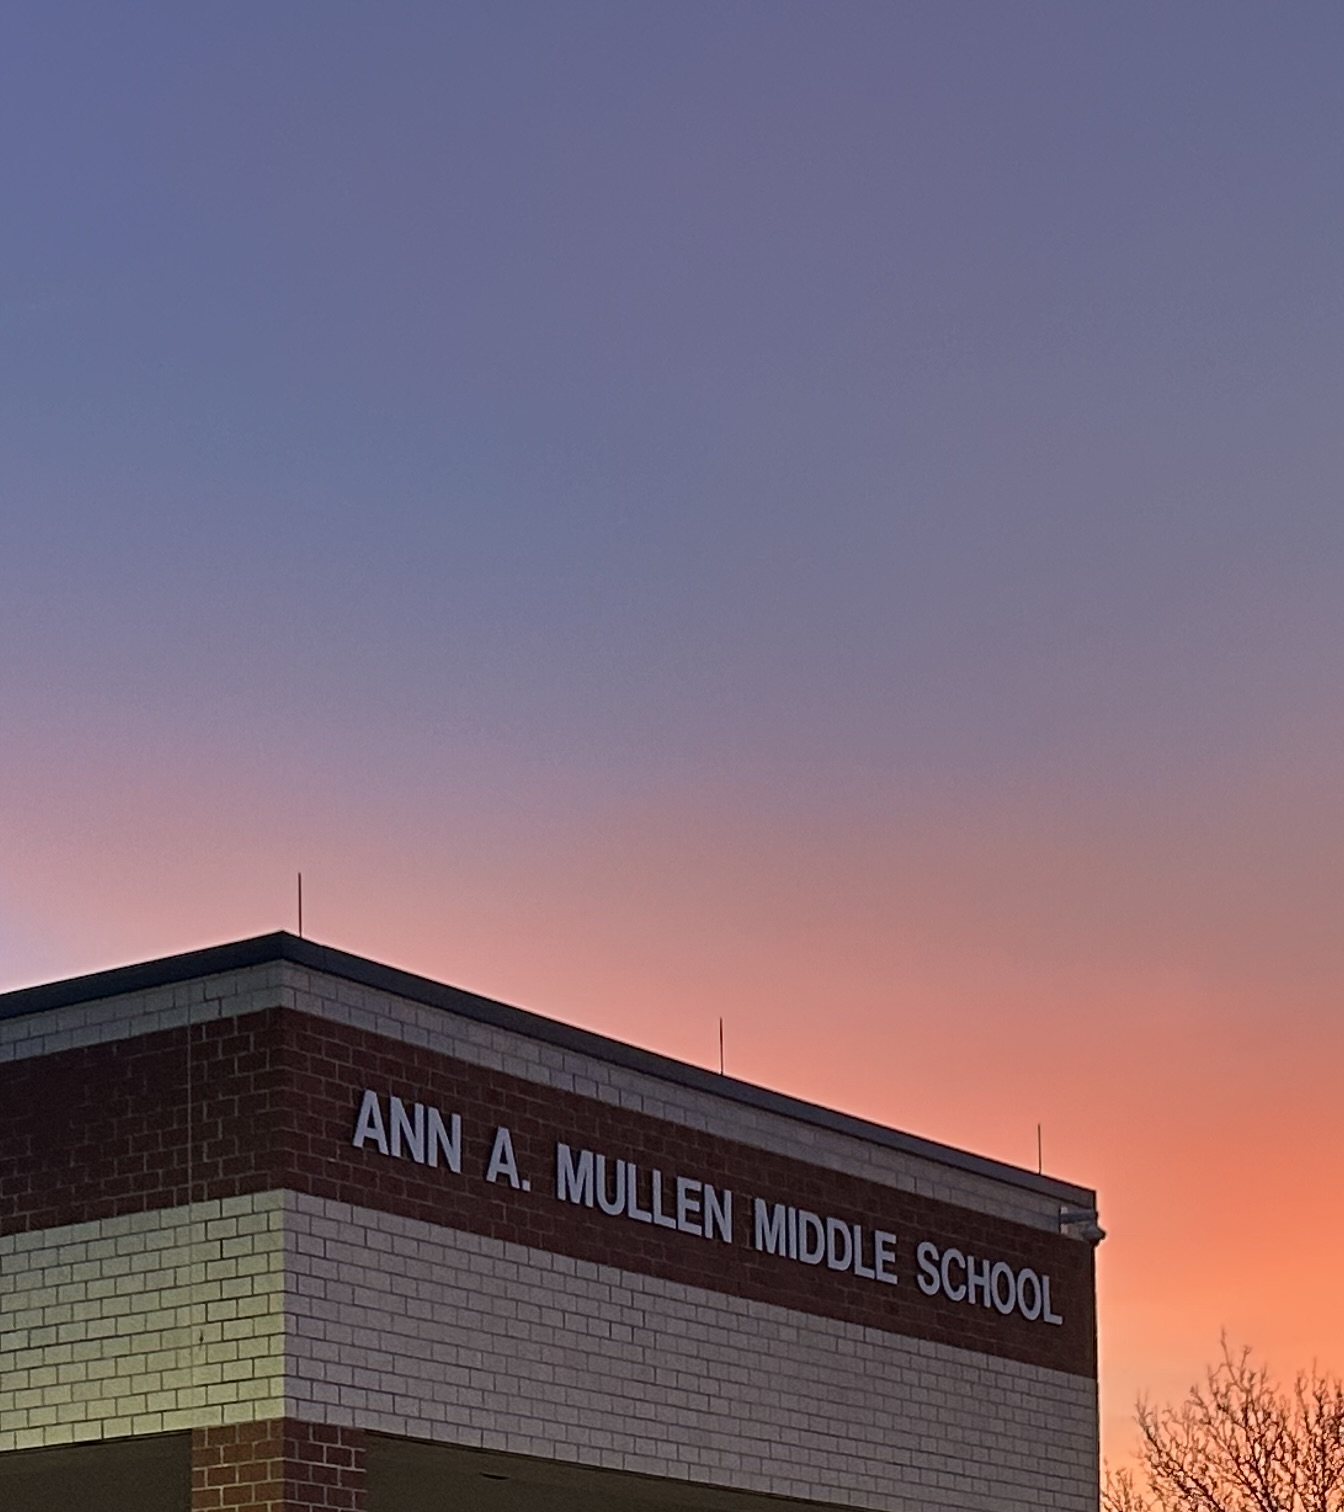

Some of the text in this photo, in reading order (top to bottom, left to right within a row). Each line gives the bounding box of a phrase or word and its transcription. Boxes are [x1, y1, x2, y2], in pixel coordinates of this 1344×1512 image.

[353, 1090, 1063, 1325] ANN A. MULLEN MIDDLE SCHOOL
